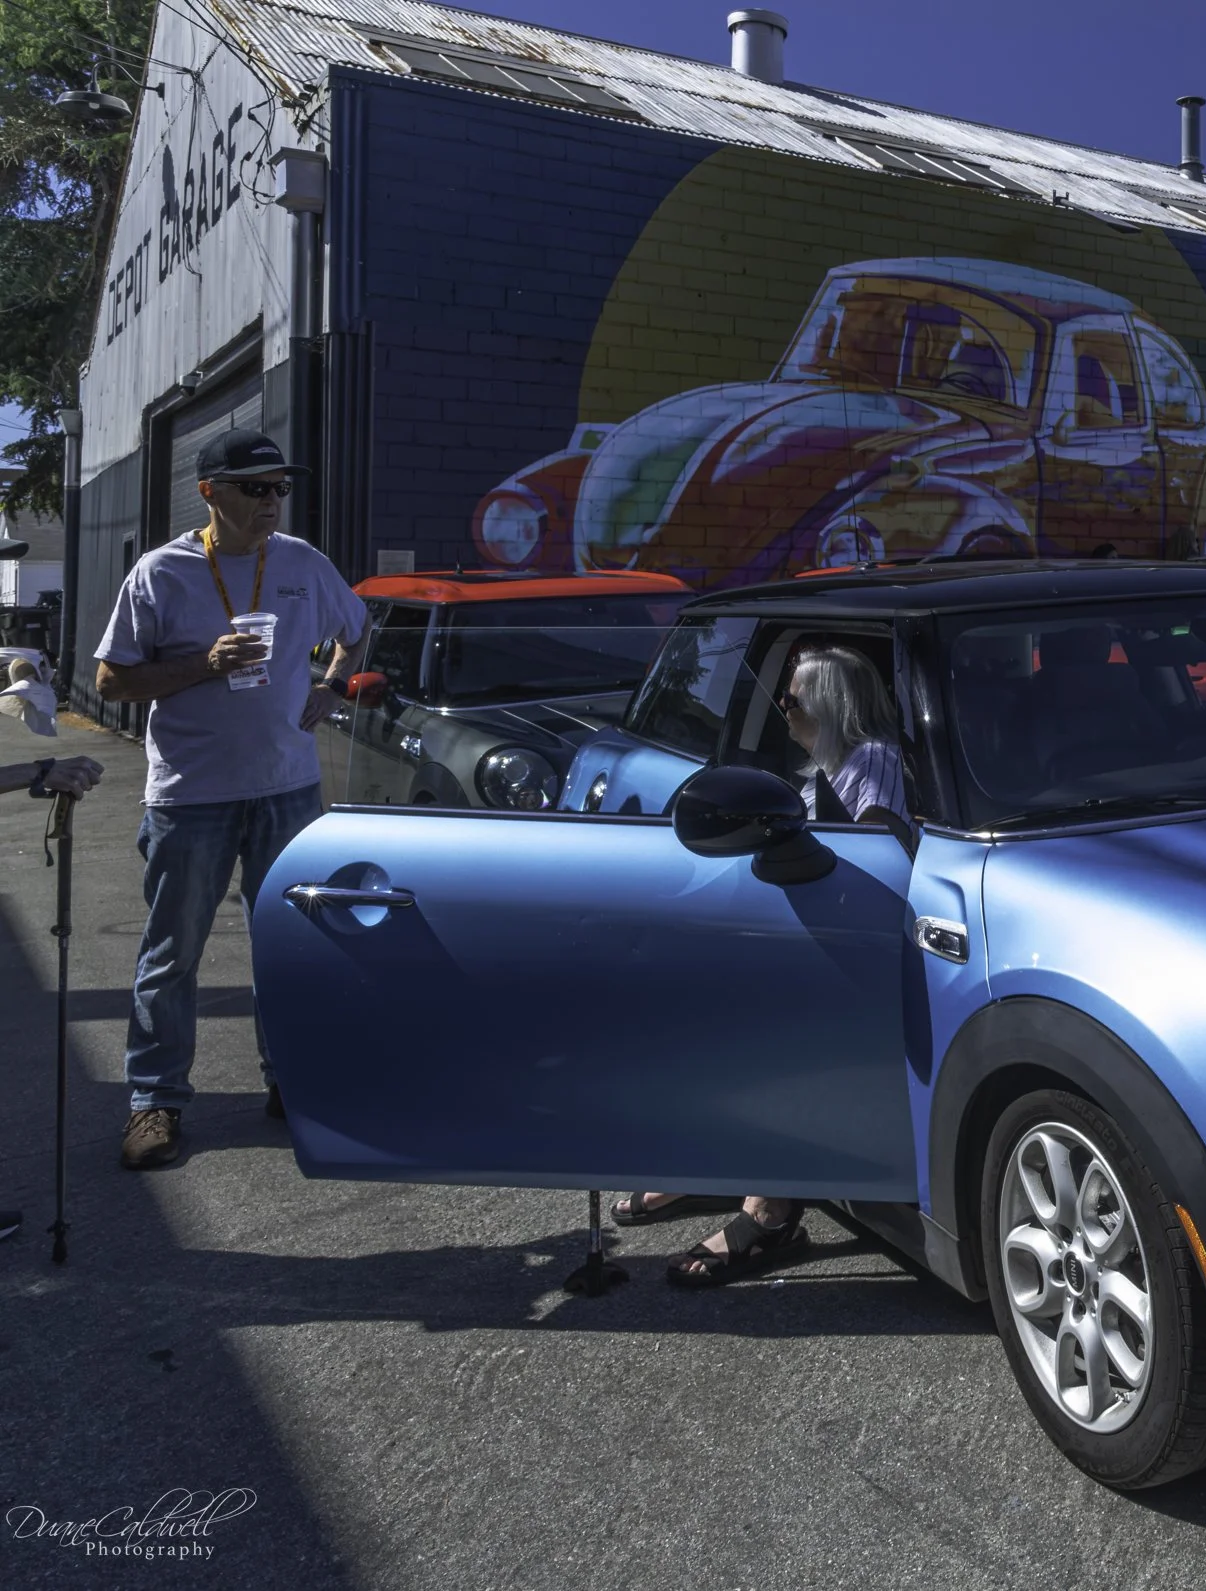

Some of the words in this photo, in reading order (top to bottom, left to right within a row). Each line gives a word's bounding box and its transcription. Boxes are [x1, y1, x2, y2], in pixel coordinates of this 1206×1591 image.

[107, 227, 152, 347] DEPOT
[158, 101, 243, 285] GARAGE
[1070, 1258, 1079, 1288] MINI
